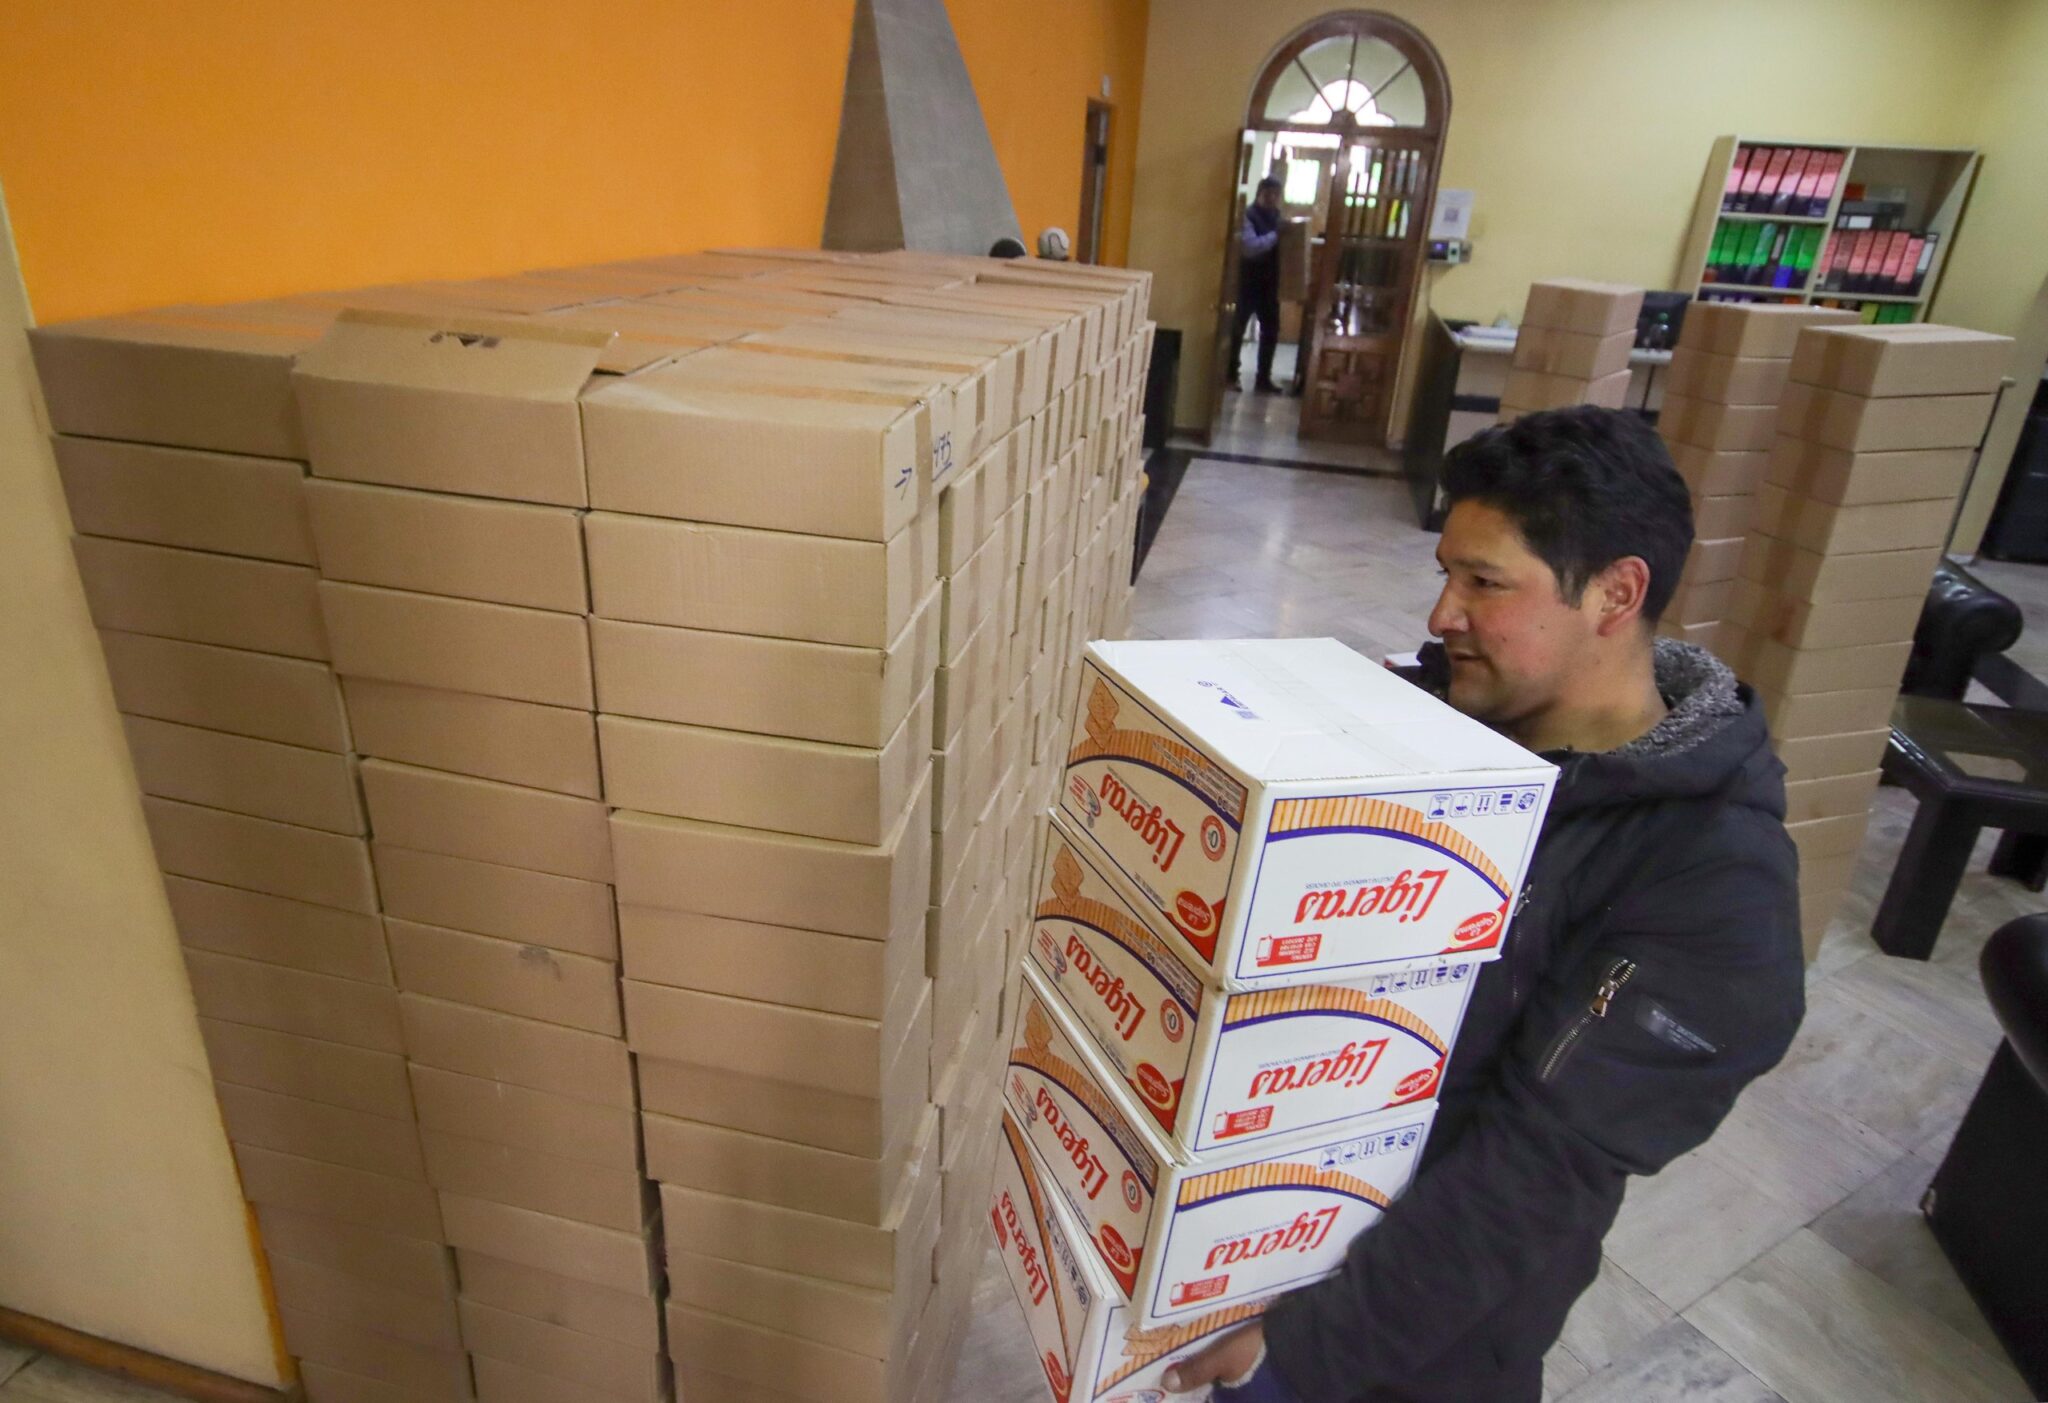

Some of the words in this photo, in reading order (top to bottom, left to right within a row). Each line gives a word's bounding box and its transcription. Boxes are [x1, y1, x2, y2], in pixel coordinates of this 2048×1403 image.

[1098, 773, 1185, 873] Ligeras
[1294, 870, 1448, 923] Ligeras
[1064, 935, 1146, 1040] Ligeras
[1248, 1038, 1390, 1099] Ligeras
[1035, 1088, 1109, 1200] Ligeras
[999, 1192, 1049, 1305] Ligeras
[1204, 1205, 1341, 1269] Ligeras
